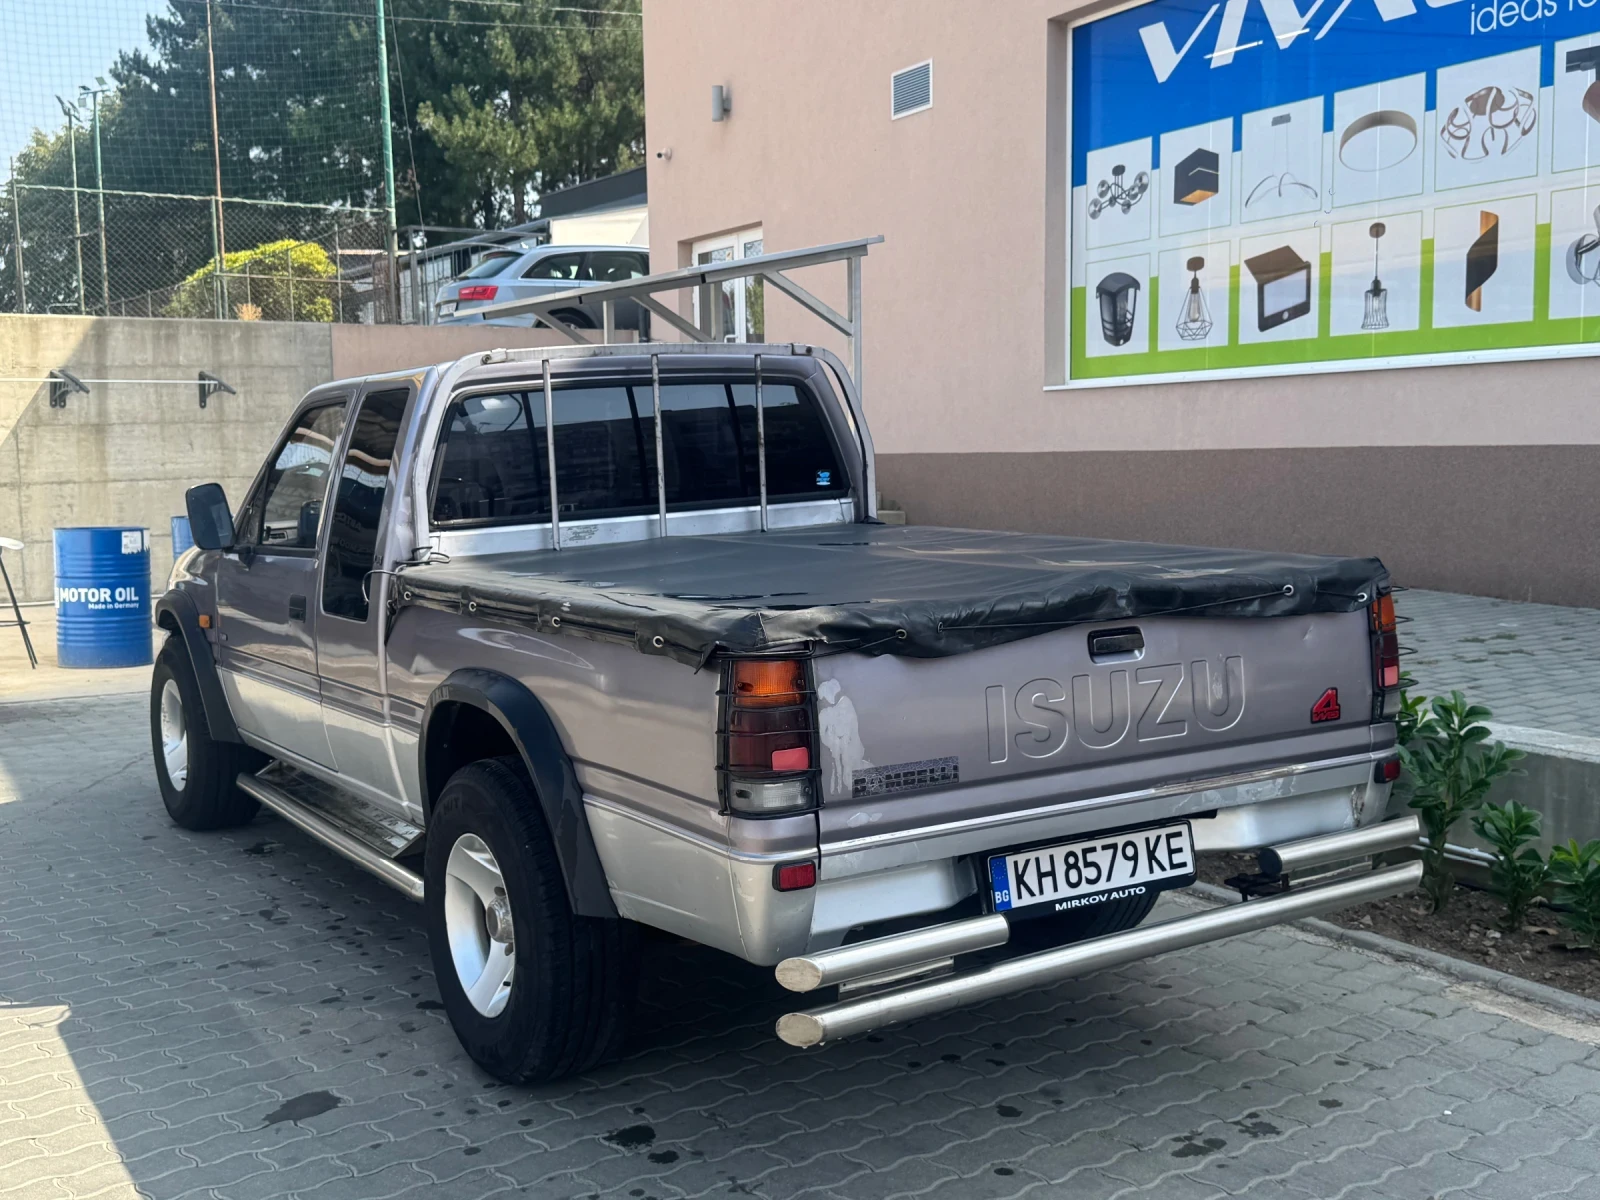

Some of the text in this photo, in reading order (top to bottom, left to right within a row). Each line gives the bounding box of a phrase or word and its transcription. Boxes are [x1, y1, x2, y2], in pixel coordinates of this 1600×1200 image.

[1471, 0, 1558, 35] ideas
[60, 587, 139, 602] MOTOR OIL
[984, 655, 1245, 764] ISUZU
[1013, 830, 1188, 900] KH 8579 KE
[995, 890, 1010, 904] BG
[1055, 886, 1146, 911] MIRKOV AUTO
